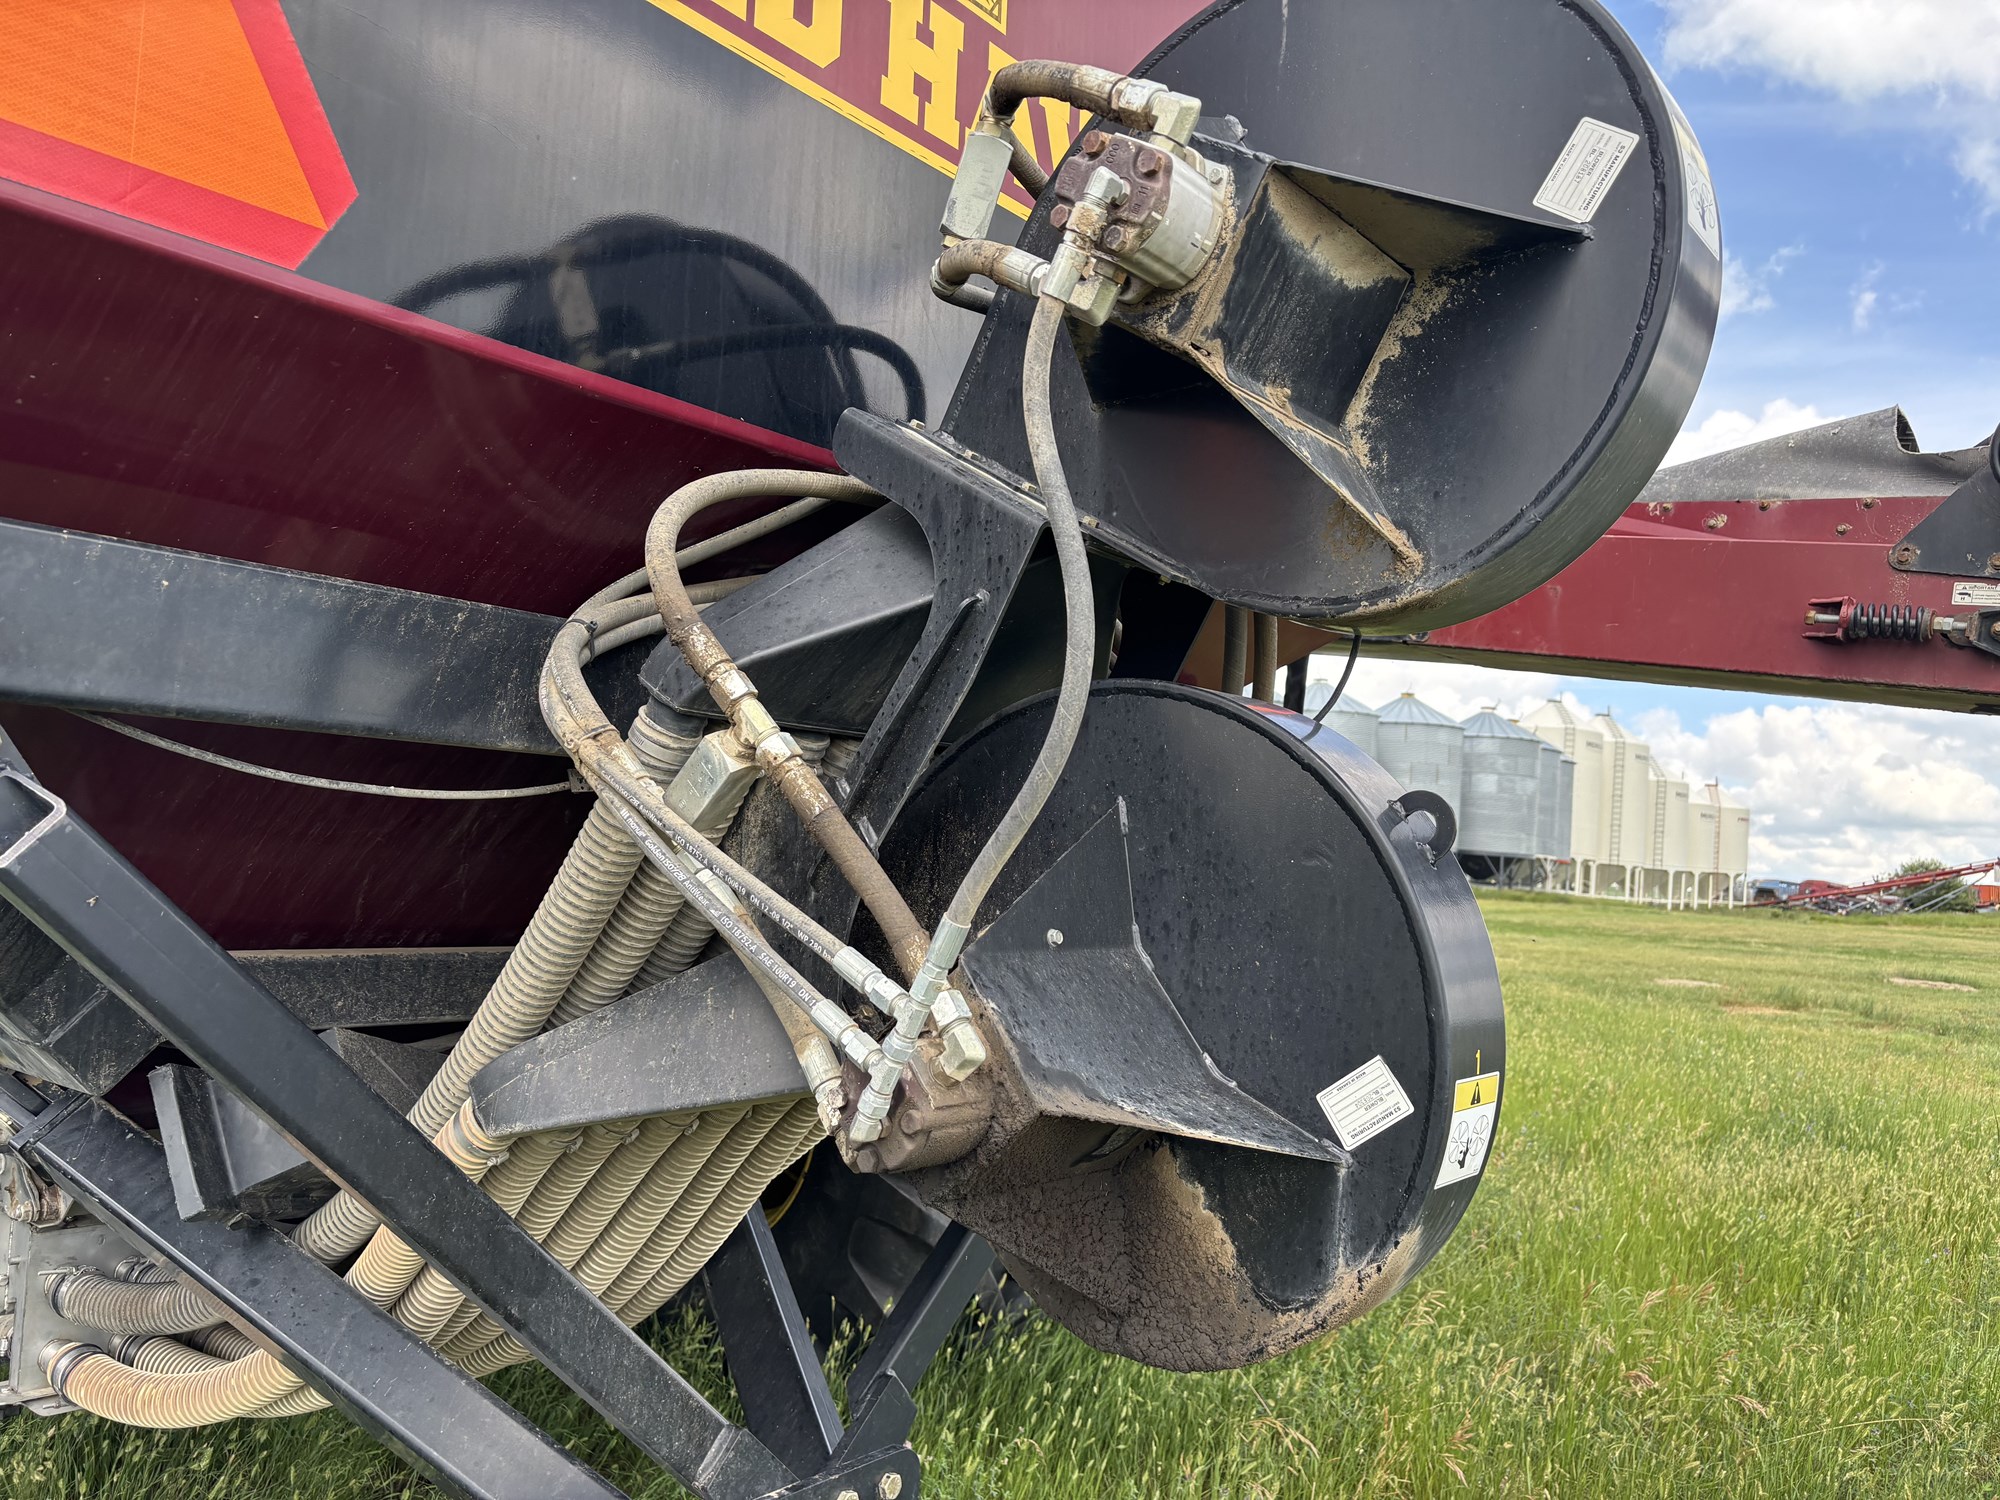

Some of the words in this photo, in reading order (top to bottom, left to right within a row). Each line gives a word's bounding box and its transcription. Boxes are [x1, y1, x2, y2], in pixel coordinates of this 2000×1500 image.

[1566, 143, 1575, 156] MADE
[1586, 150, 1603, 176] BLOWER
[1551, 163, 1563, 181] CANADA
[1583, 154, 1619, 211] MANUFACTURING
[675, 834, 686, 847] ISO
[686, 842, 708, 866] 18752-A
[712, 865, 724, 878] SAE
[750, 894, 760, 908] DN
[760, 902, 770, 914] 12
[797, 930, 809, 943] WP
[809, 939, 822, 954] 280
[683, 879, 710, 907] AntiWear
[720, 916, 733, 930] ISO
[731, 926, 758, 954] 18752-A
[758, 951, 774, 968] SAE
[772, 963, 798, 988] 100R19
[798, 987, 812, 1006] DN
[1364, 1097, 1384, 1111] BLOWER
[1351, 1110, 1394, 1140] MANUFACTURING
